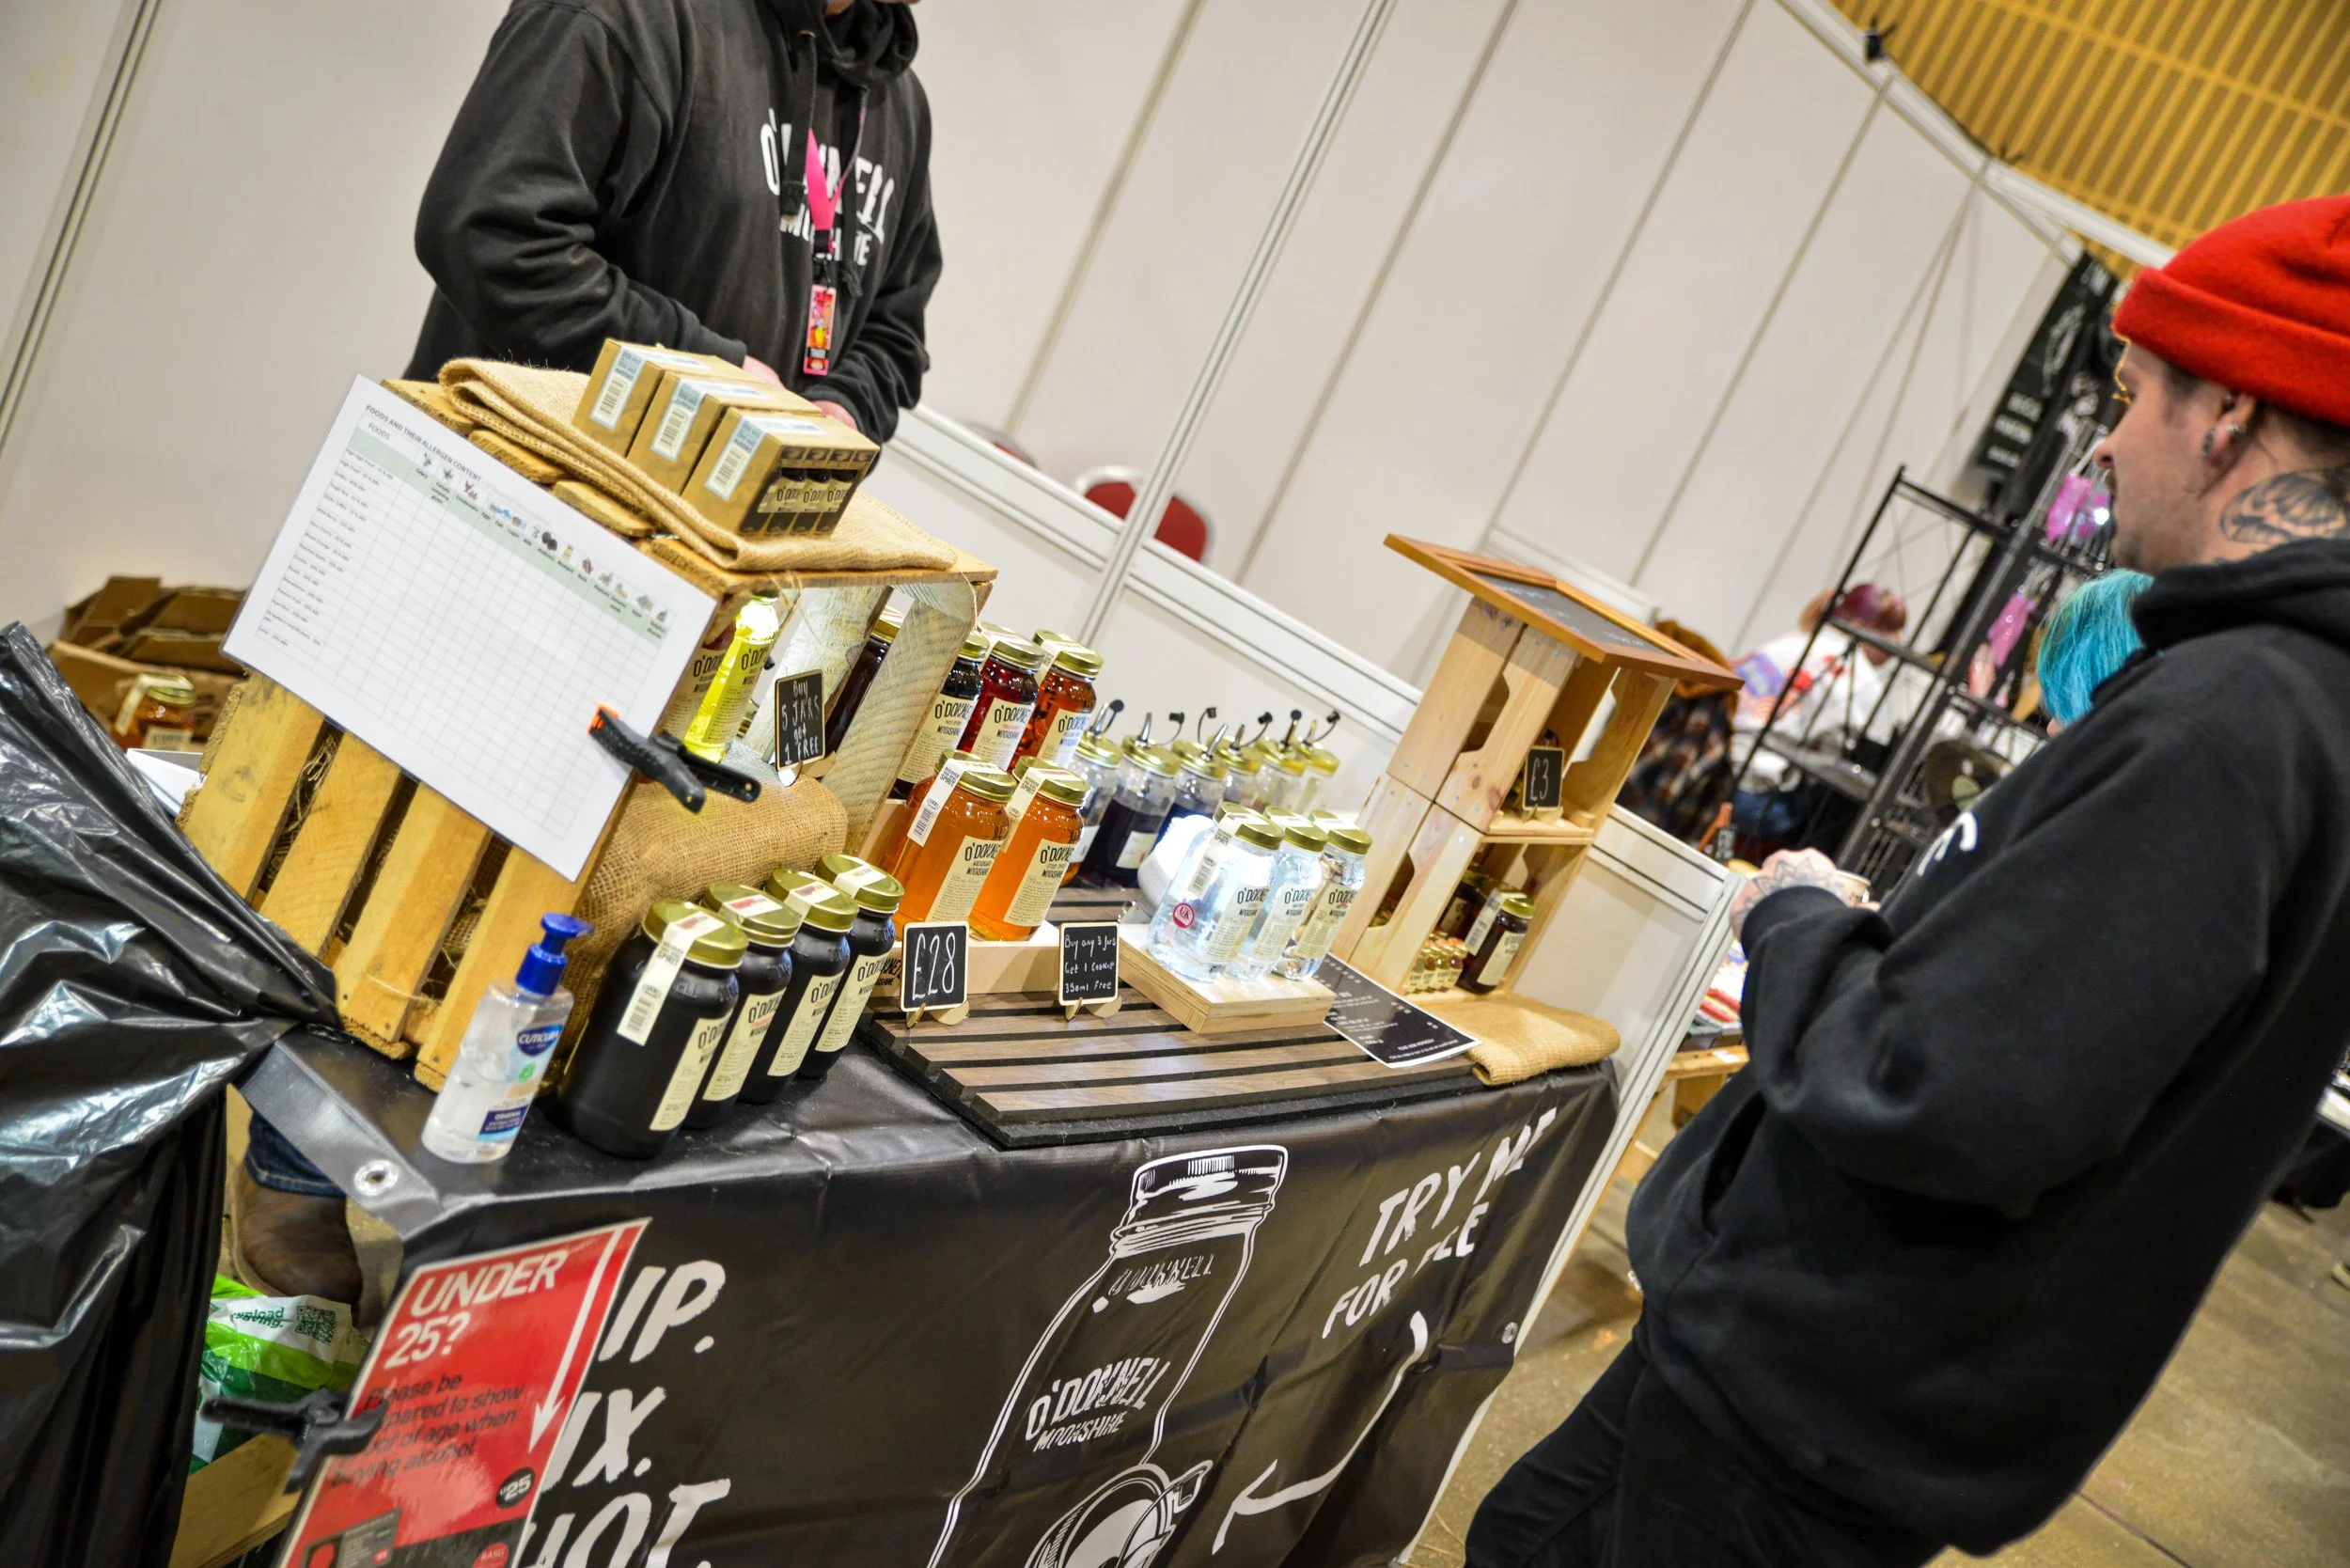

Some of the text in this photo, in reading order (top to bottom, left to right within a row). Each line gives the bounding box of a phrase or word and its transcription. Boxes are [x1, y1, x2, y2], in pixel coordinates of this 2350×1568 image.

[365, 403, 481, 482] FOODS AND THEIR ALLERGEN CONTENT
[367, 421, 391, 441] FOODS
[781, 694, 820, 731] 5 JARS
[793, 680, 808, 704] Buy
[785, 735, 819, 765] 1 FREE
[940, 774, 955, 787] SPIRIT
[1021, 783, 1035, 795] SPIRIT
[1529, 757, 1549, 801] £3
[657, 950, 681, 966] SPIRIT
[912, 932, 956, 1001] £28
[1064, 934, 1078, 960] Buy
[1081, 939, 1095, 957] any
[1097, 935, 1102, 946] 3
[1064, 962, 1078, 974] Get
[1091, 962, 1115, 972] Cookie
[1064, 980, 1111, 994] 350ml Free
[1359, 1152, 1481, 1267] TRY
[411, 1250, 569, 1317] UNDER
[1323, 1259, 1408, 1340] FOR
[597, 1260, 726, 1363] IP.
[384, 1311, 471, 1370] 25?
[436, 1372, 463, 1393] be
[1025, 1357, 1171, 1441] O'DONNELL
[382, 1385, 525, 1431] pared to show
[400, 1427, 420, 1448] of
[426, 1420, 460, 1445] age
[464, 1409, 518, 1435] when
[540, 1386, 667, 1496] IX.
[1033, 1411, 1128, 1451] MOONSHINE
[331, 1436, 478, 1487] buying alcohol
[522, 1478, 731, 1568] HOT.
